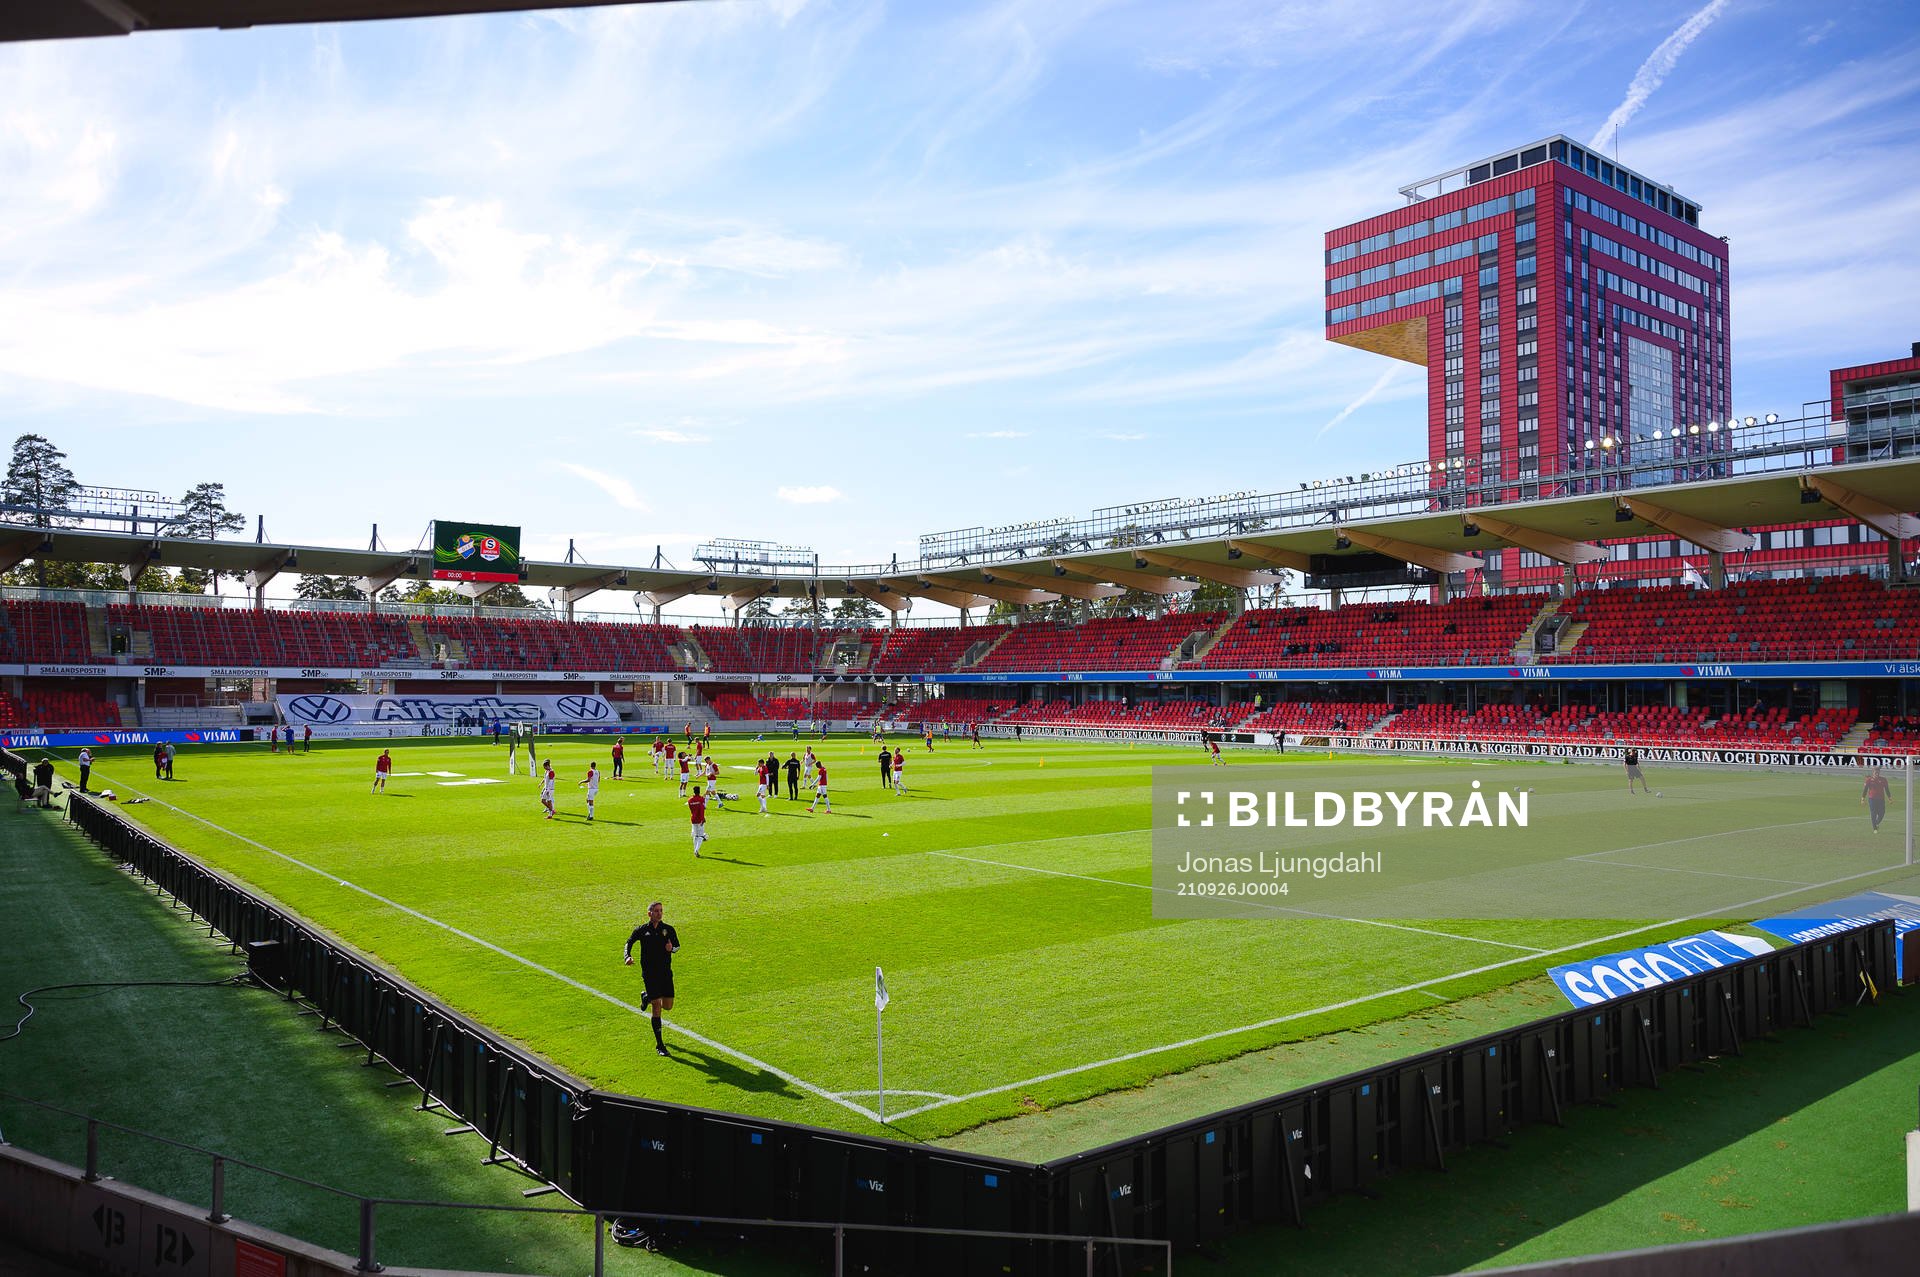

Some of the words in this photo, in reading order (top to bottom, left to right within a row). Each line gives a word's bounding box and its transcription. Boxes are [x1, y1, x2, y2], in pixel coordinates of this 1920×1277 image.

[40, 667, 107, 675] SMÅLANDSPOSTEN
[210, 669, 269, 677] SMÅLANDSPOSTEN
[1522, 668, 1550, 677] VISMA
[1697, 666, 1732, 676] VISMA
[1884, 664, 1896, 673] Vi
[1257, 671, 1278, 679] VISMA
[1378, 669, 1402, 679] VISMA
[11, 736, 49, 746] VISMA
[113, 733, 150, 744] VISMA
[203, 731, 237, 741] VISMA
[1139, 732, 1166, 741] LOKALA
[1328, 737, 1349, 747] MED
[1400, 740, 1421, 750] DEN
[1531, 745, 1548, 755] DE
[1724, 750, 1756, 764] OCH
[1759, 752, 1791, 766] DEN
[1794, 753, 1858, 767] LOKALA
[155, 1223, 179, 1268] J2
